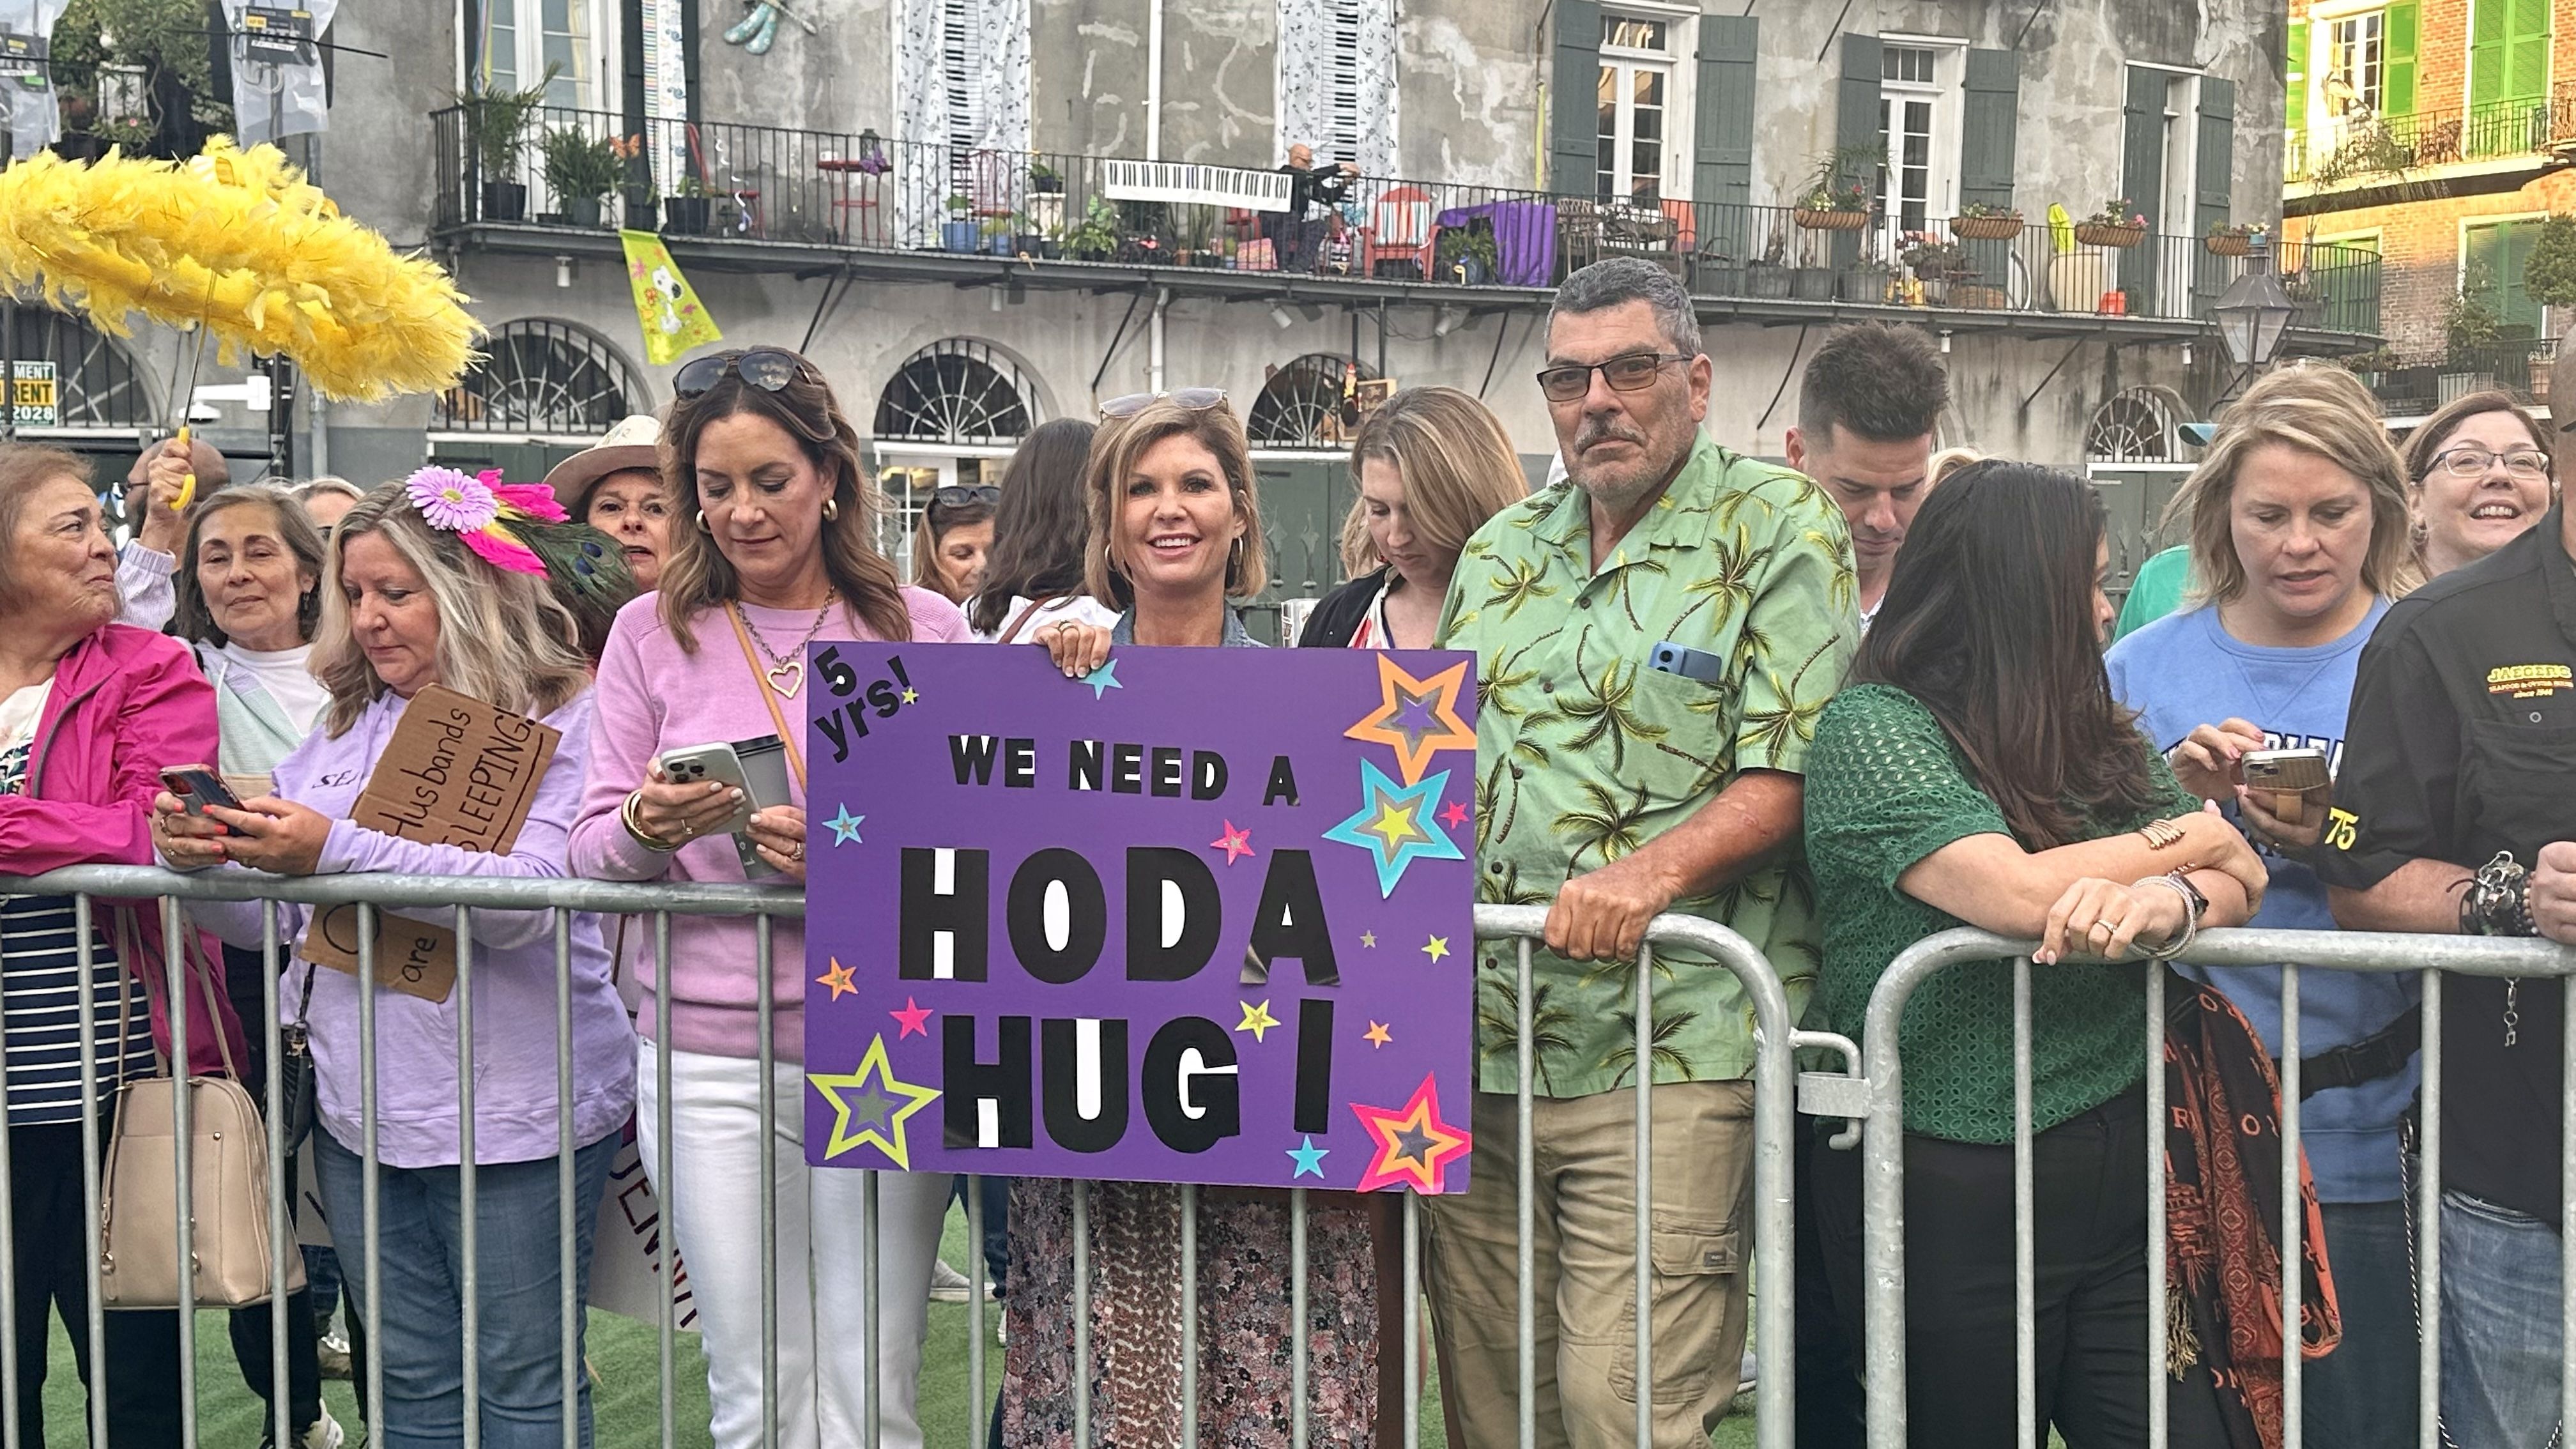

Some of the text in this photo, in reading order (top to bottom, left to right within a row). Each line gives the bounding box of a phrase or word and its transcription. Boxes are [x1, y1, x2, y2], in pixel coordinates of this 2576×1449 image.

[13, 365, 51, 379] MENT
[814, 645, 857, 696] 5
[814, 655, 920, 763] yrs!
[378, 708, 471, 835] Husbands
[948, 735, 1301, 806] WE NEED A
[2324, 807, 2359, 851] 75
[900, 847, 1340, 986] HODA
[402, 937, 443, 983] are
